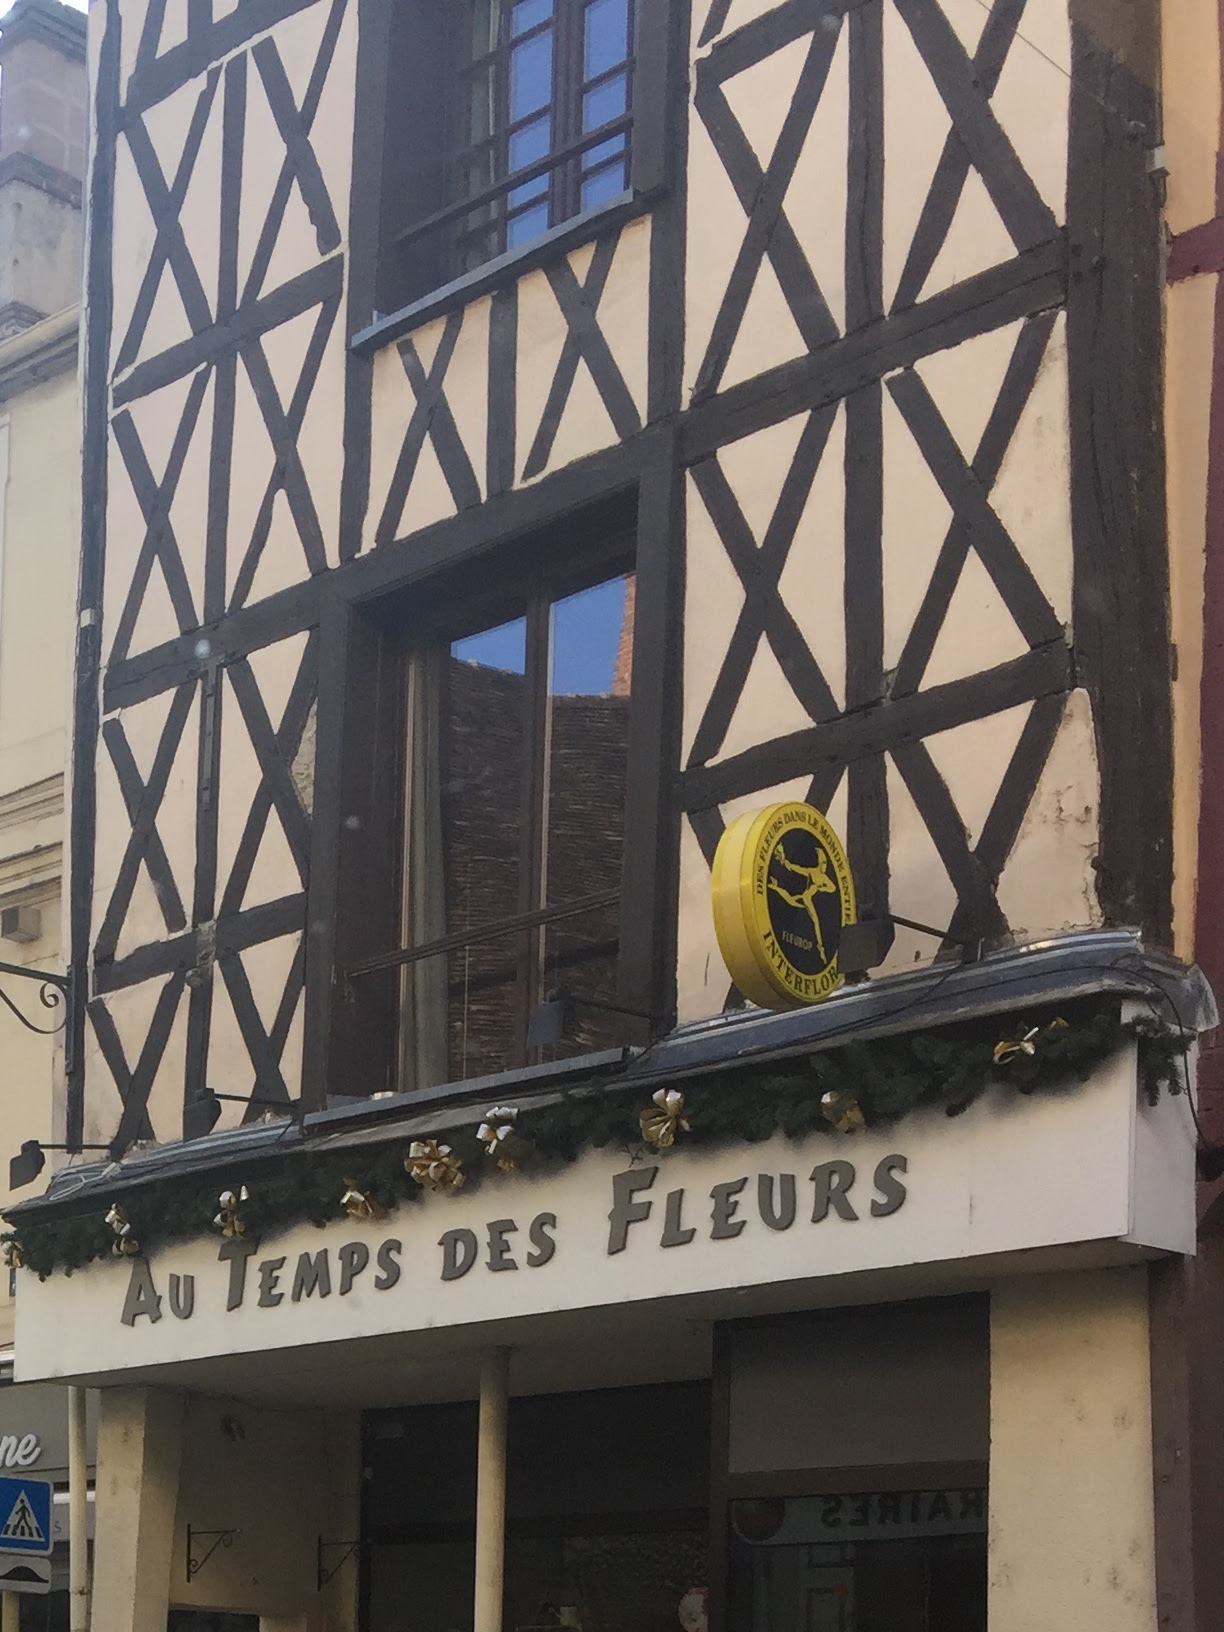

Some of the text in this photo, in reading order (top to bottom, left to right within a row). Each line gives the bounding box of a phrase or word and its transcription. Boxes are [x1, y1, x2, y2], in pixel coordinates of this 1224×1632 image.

[756, 866, 764, 896] DES
[760, 816, 784, 862] FLEURS
[783, 810, 807, 825] DANS
[807, 813, 820, 830] LE
[819, 825, 845, 873] MONDE
[762, 930, 839, 996] INTERFLOR
[782, 930, 813, 951] FLEUROP
[120, 1153, 909, 1328] AU TEMPS DES FLEURS
